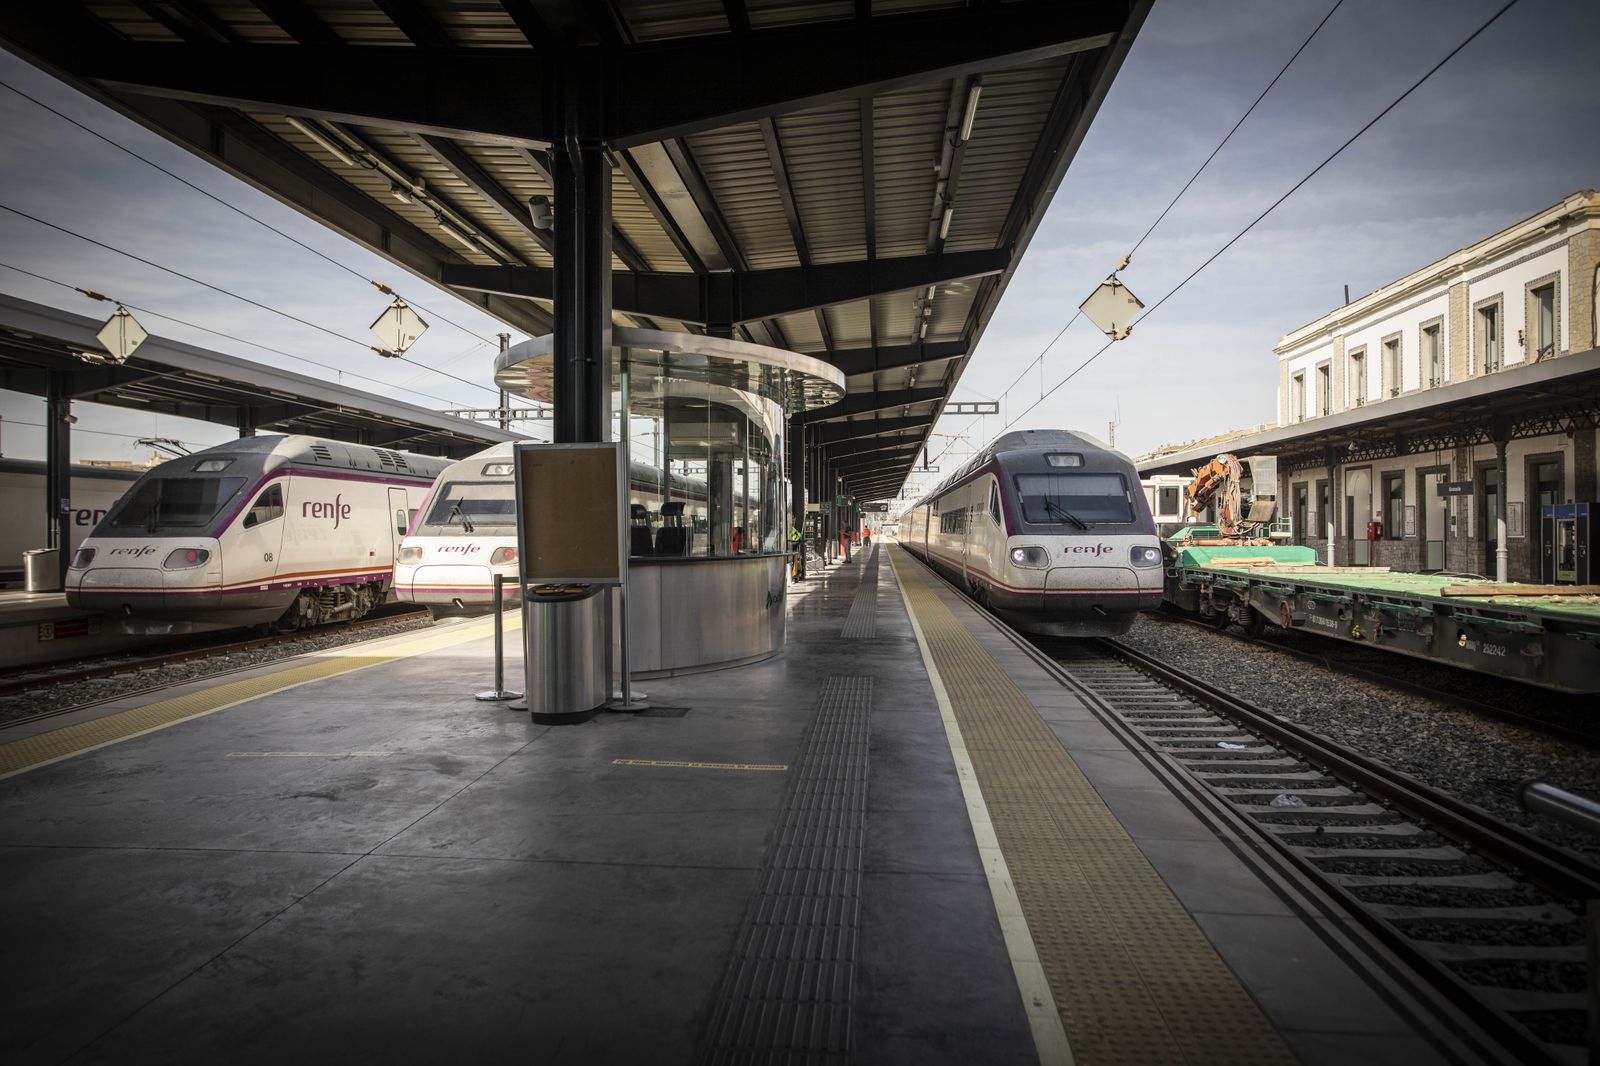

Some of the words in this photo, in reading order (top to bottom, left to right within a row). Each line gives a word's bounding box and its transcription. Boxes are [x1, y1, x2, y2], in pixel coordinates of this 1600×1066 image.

[302, 493, 351, 529] renfe
[110, 544, 156, 558] renfe
[437, 543, 480, 555] renfe
[1064, 542, 1113, 557] renfe
[264, 552, 274, 562] 08
